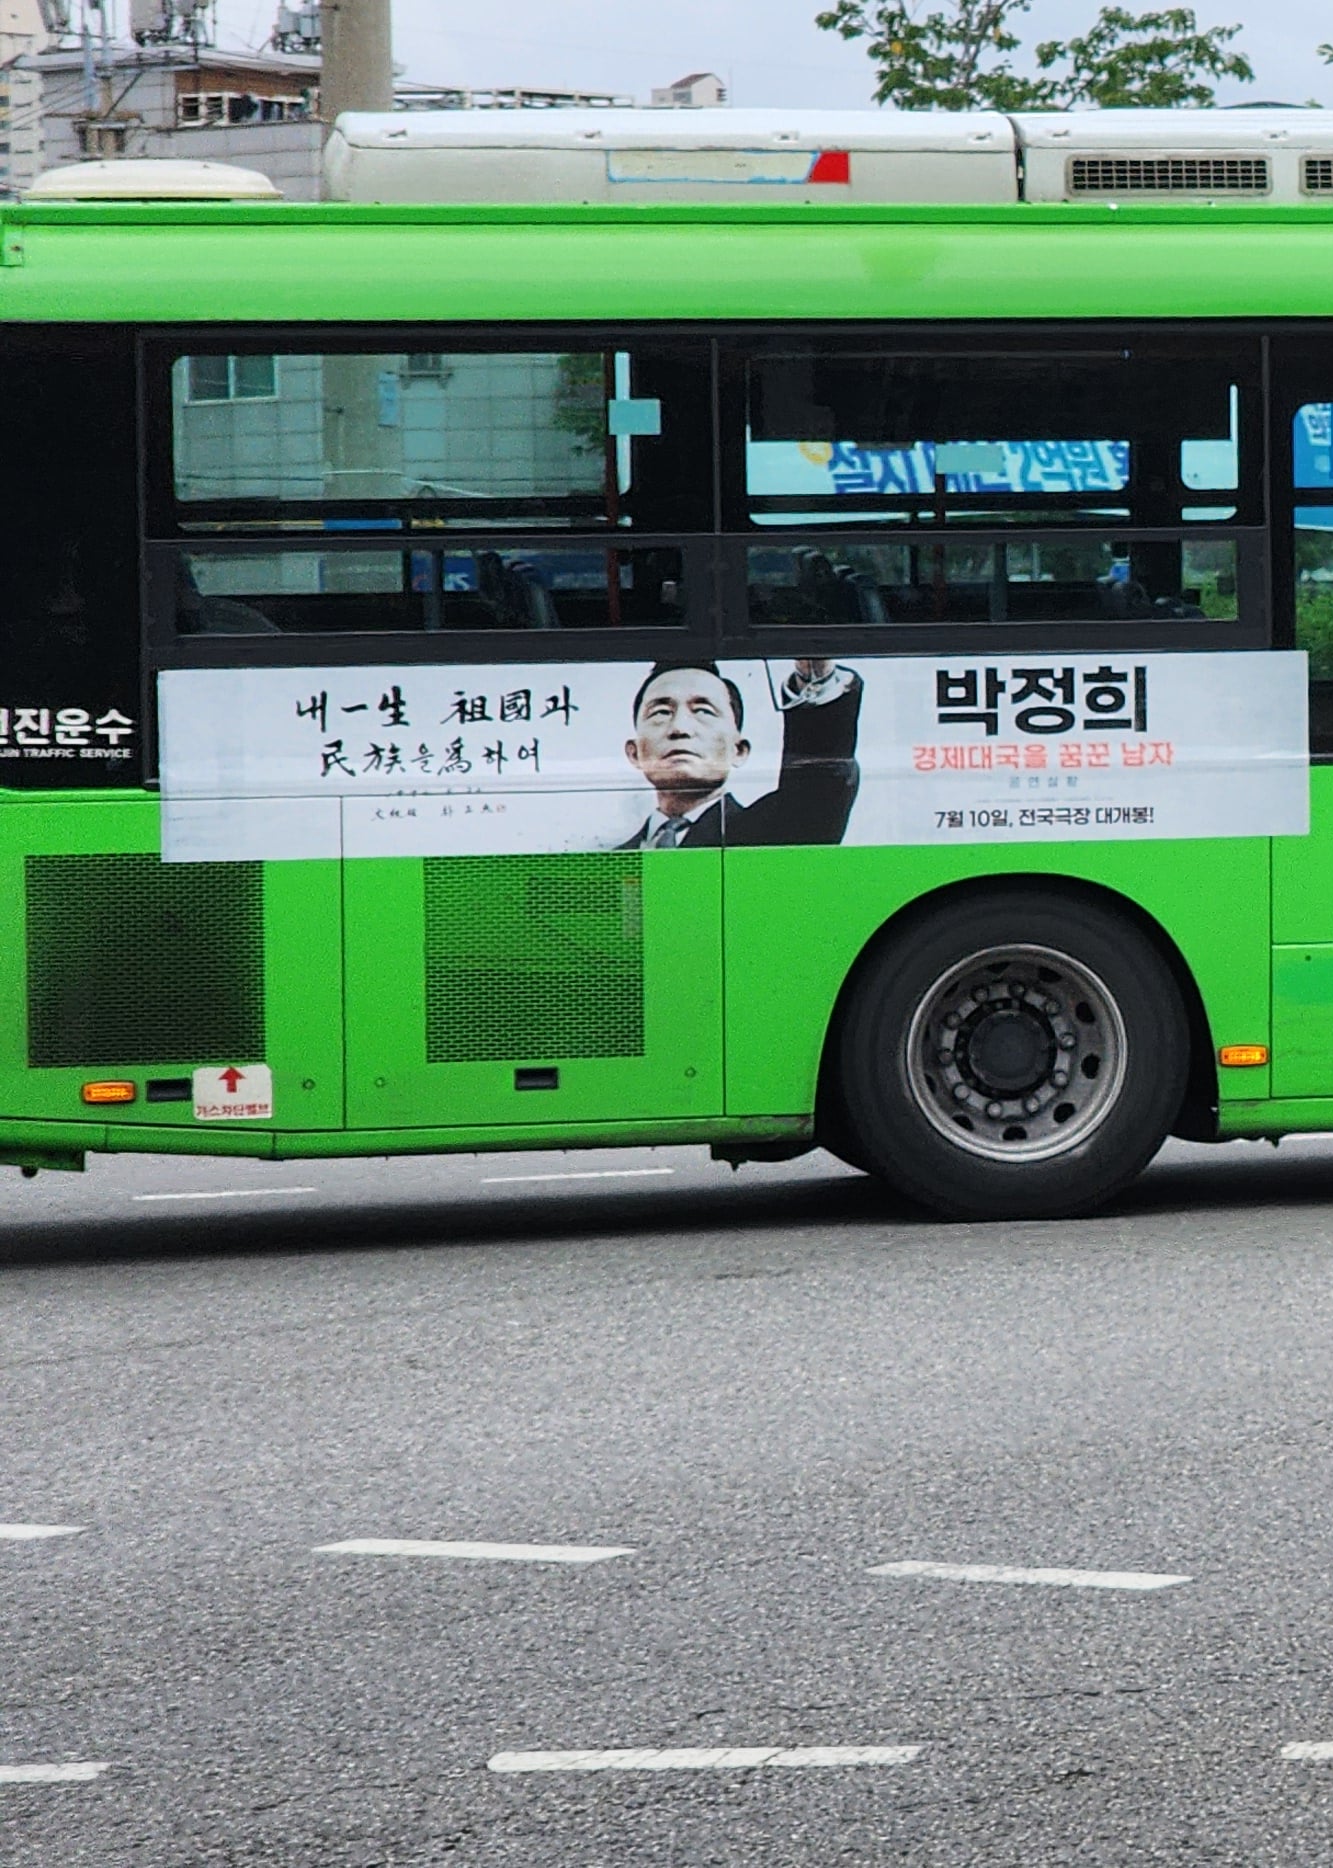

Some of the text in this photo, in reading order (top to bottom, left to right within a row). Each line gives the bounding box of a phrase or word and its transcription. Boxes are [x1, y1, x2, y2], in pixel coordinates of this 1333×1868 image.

[936, 666, 1147, 736] 박정희
[23, 748, 76, 757] TRAFFIC
[80, 748, 132, 758] SERVICE
[912, 740, 1174, 772] 경제대국을 꿈꾼 남자
[935, 806, 1154, 828] 7월 10일, 전국극장 대개봉!
